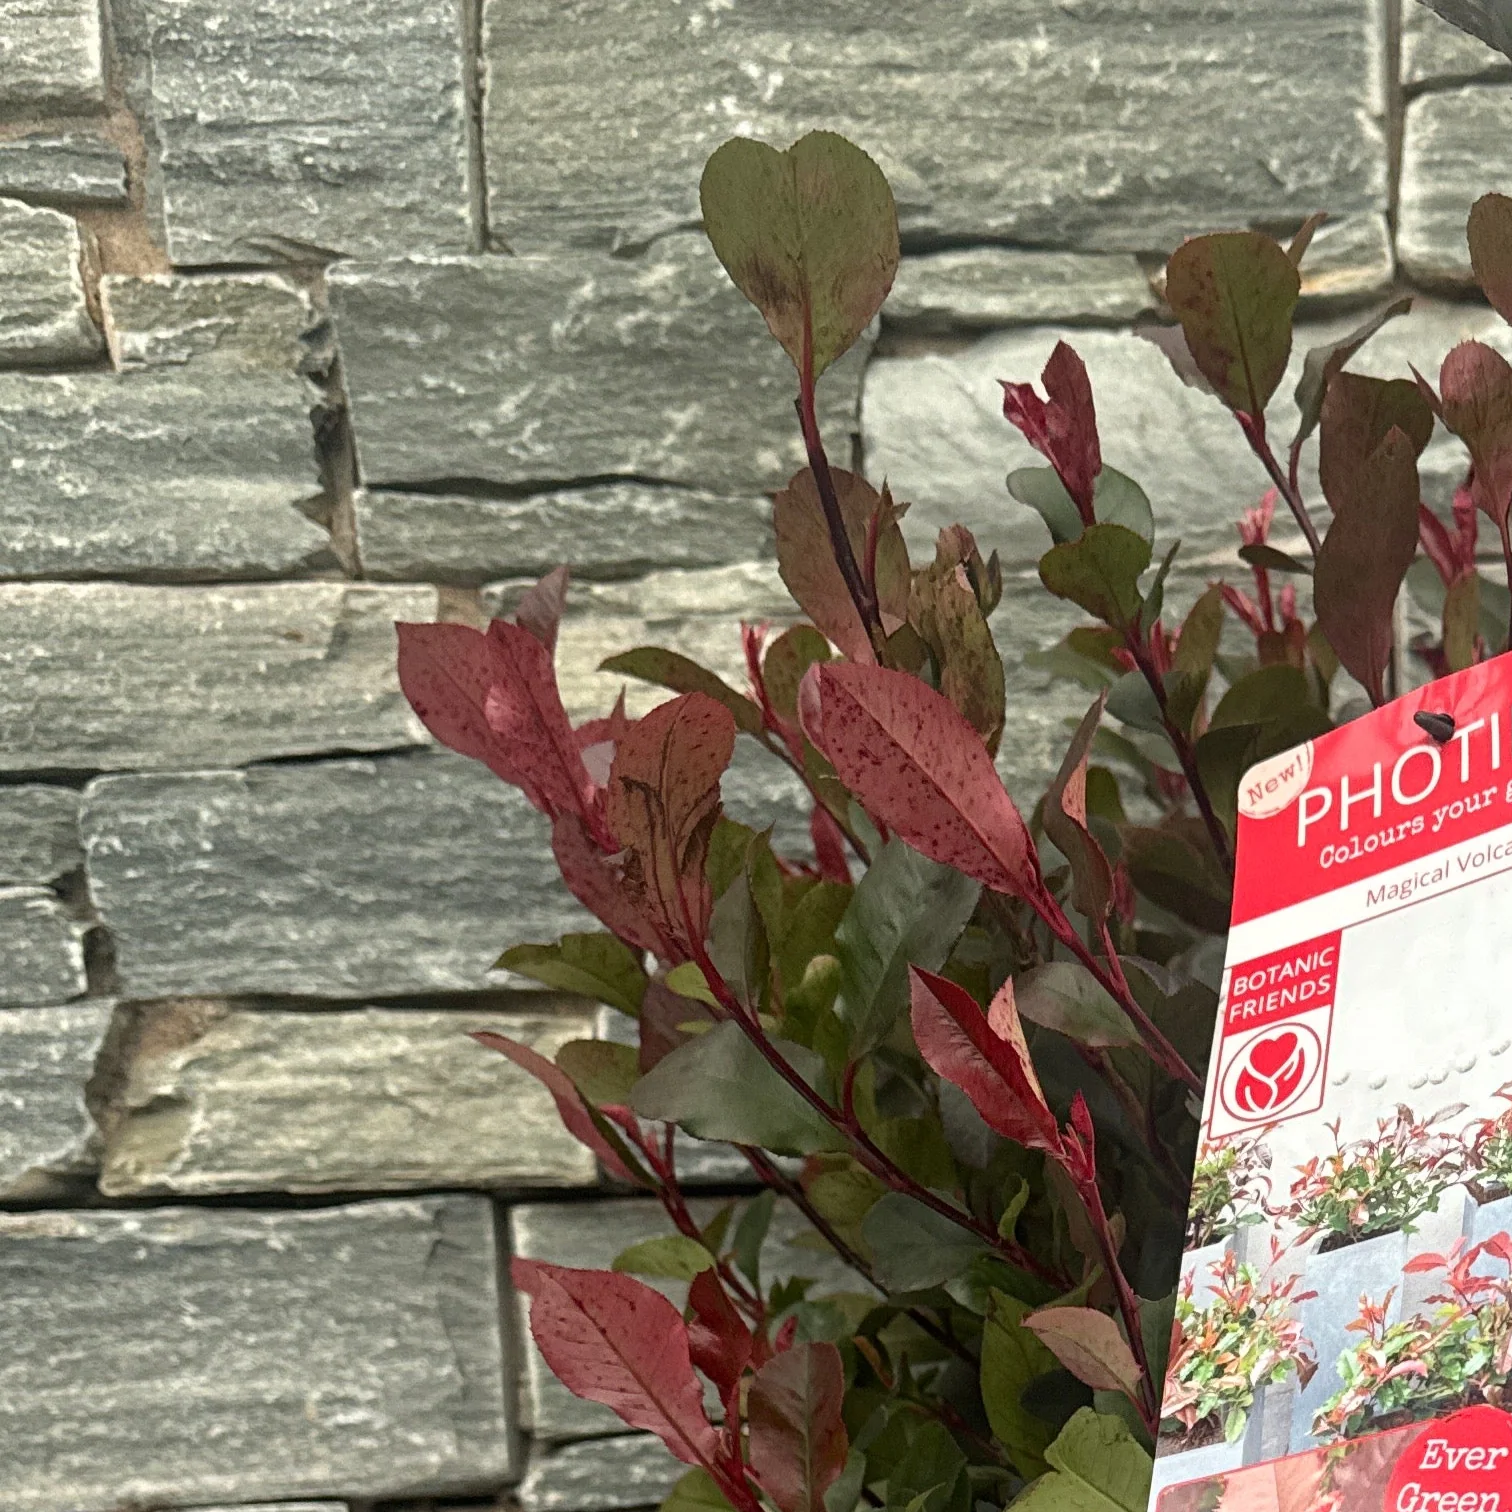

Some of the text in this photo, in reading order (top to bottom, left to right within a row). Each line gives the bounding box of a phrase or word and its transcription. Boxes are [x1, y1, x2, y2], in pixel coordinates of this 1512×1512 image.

[1246, 757, 1305, 806] New!
[1319, 815, 1425, 869] Colours
[1432, 787, 1499, 832] your
[1366, 866, 1451, 908] Magical
[1232, 946, 1335, 997] BOTANIC
[1229, 975, 1332, 1024] FRIENDS
[1419, 1438, 1509, 1471] Ever
